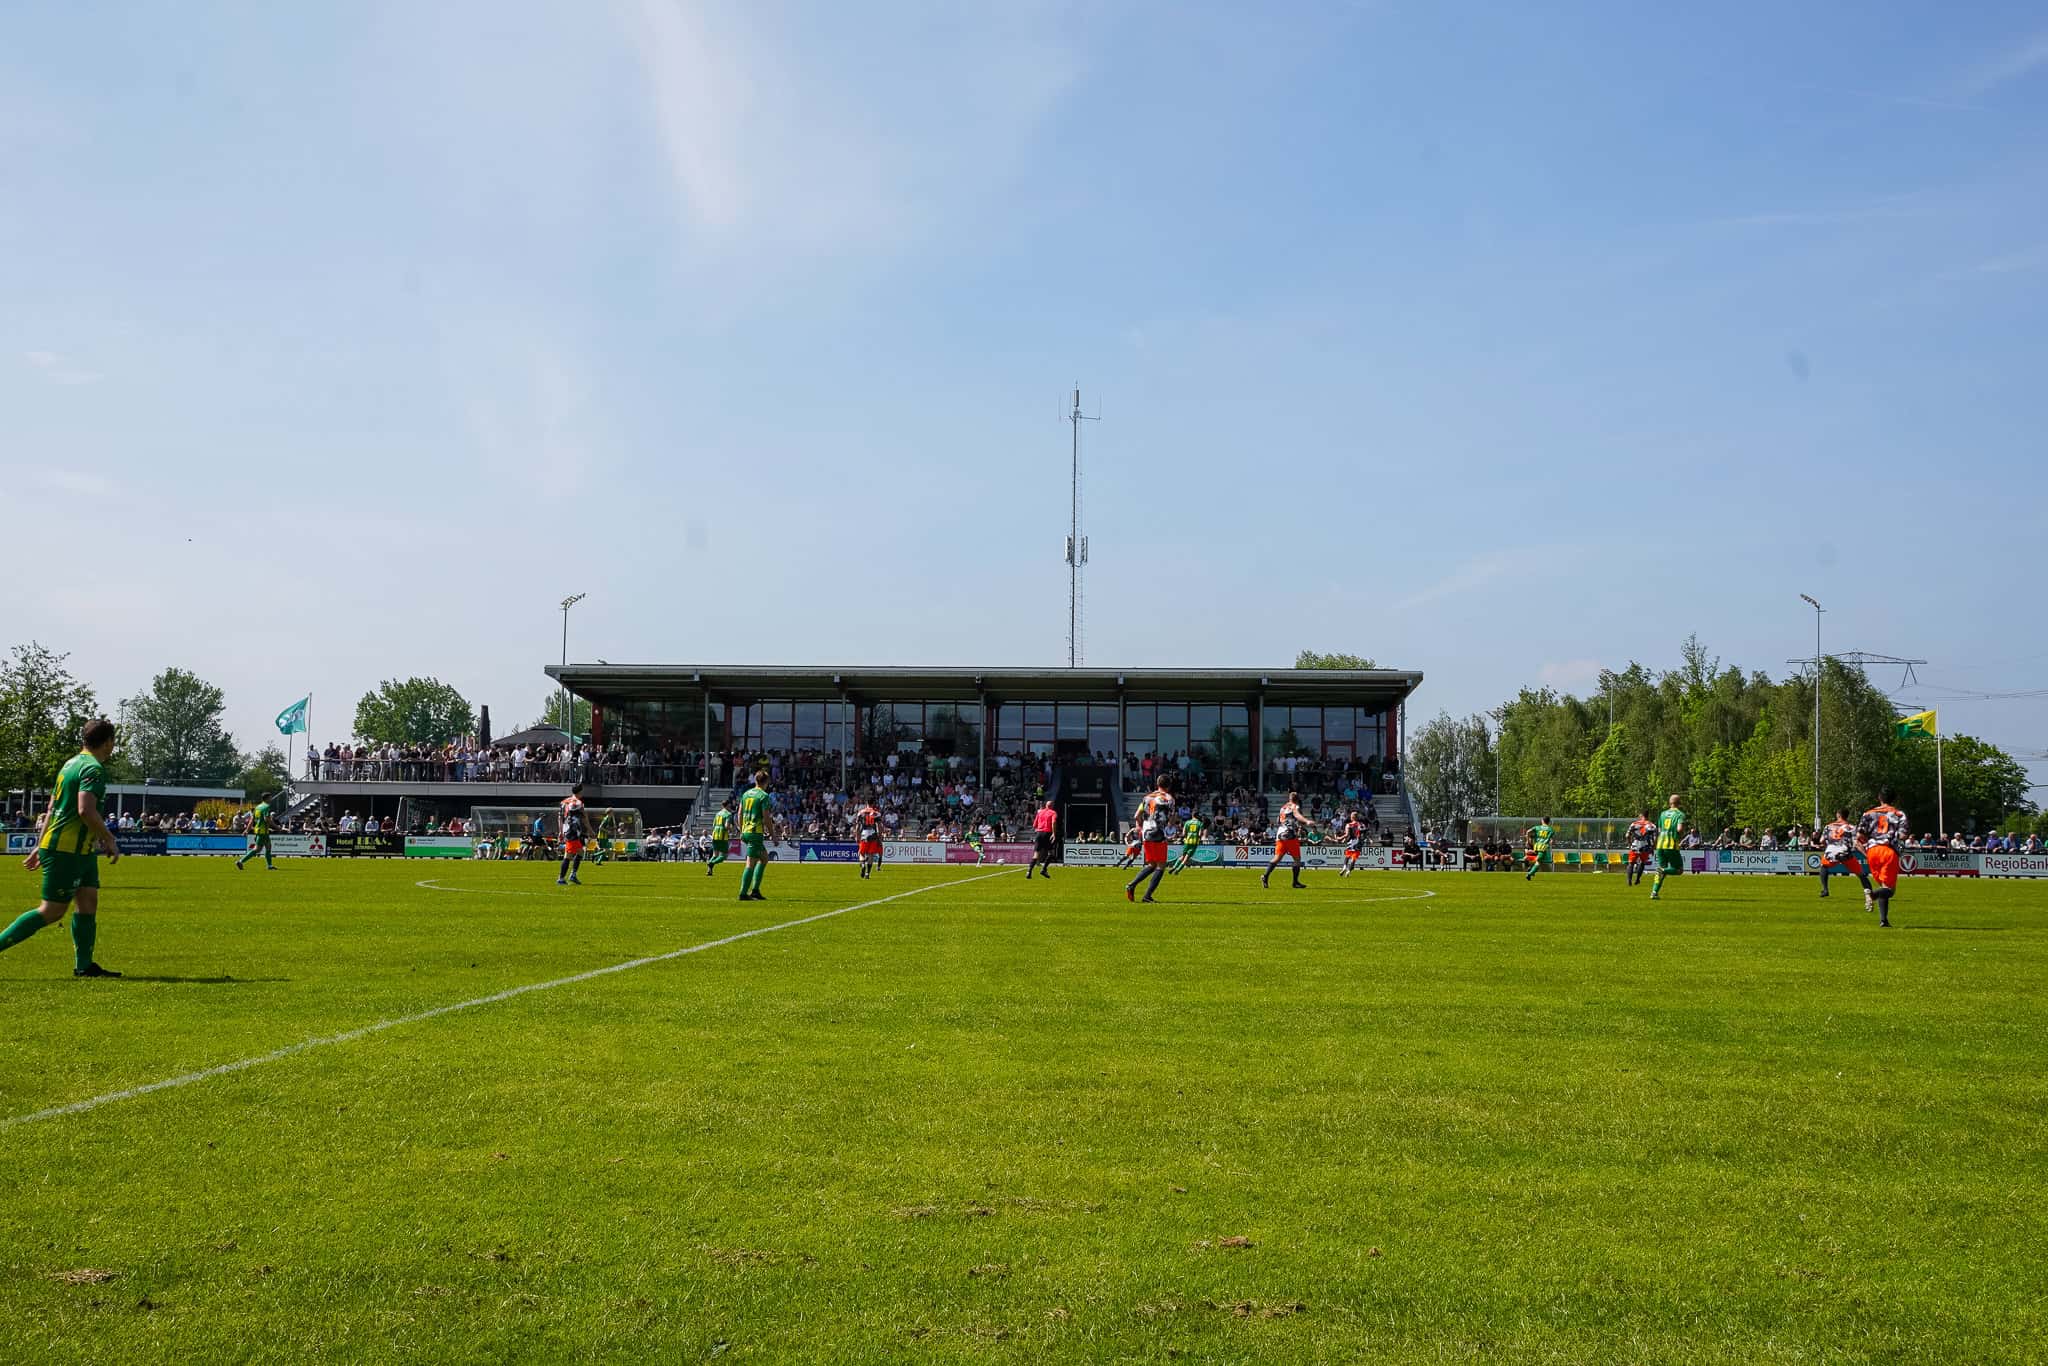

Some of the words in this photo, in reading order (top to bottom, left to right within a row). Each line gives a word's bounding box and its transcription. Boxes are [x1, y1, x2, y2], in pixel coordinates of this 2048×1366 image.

[898, 846, 933, 857] PROFILE
[1306, 847, 1327, 856] AUTO
[1732, 855, 1745, 864] DE
[1747, 855, 1771, 867] JONG
